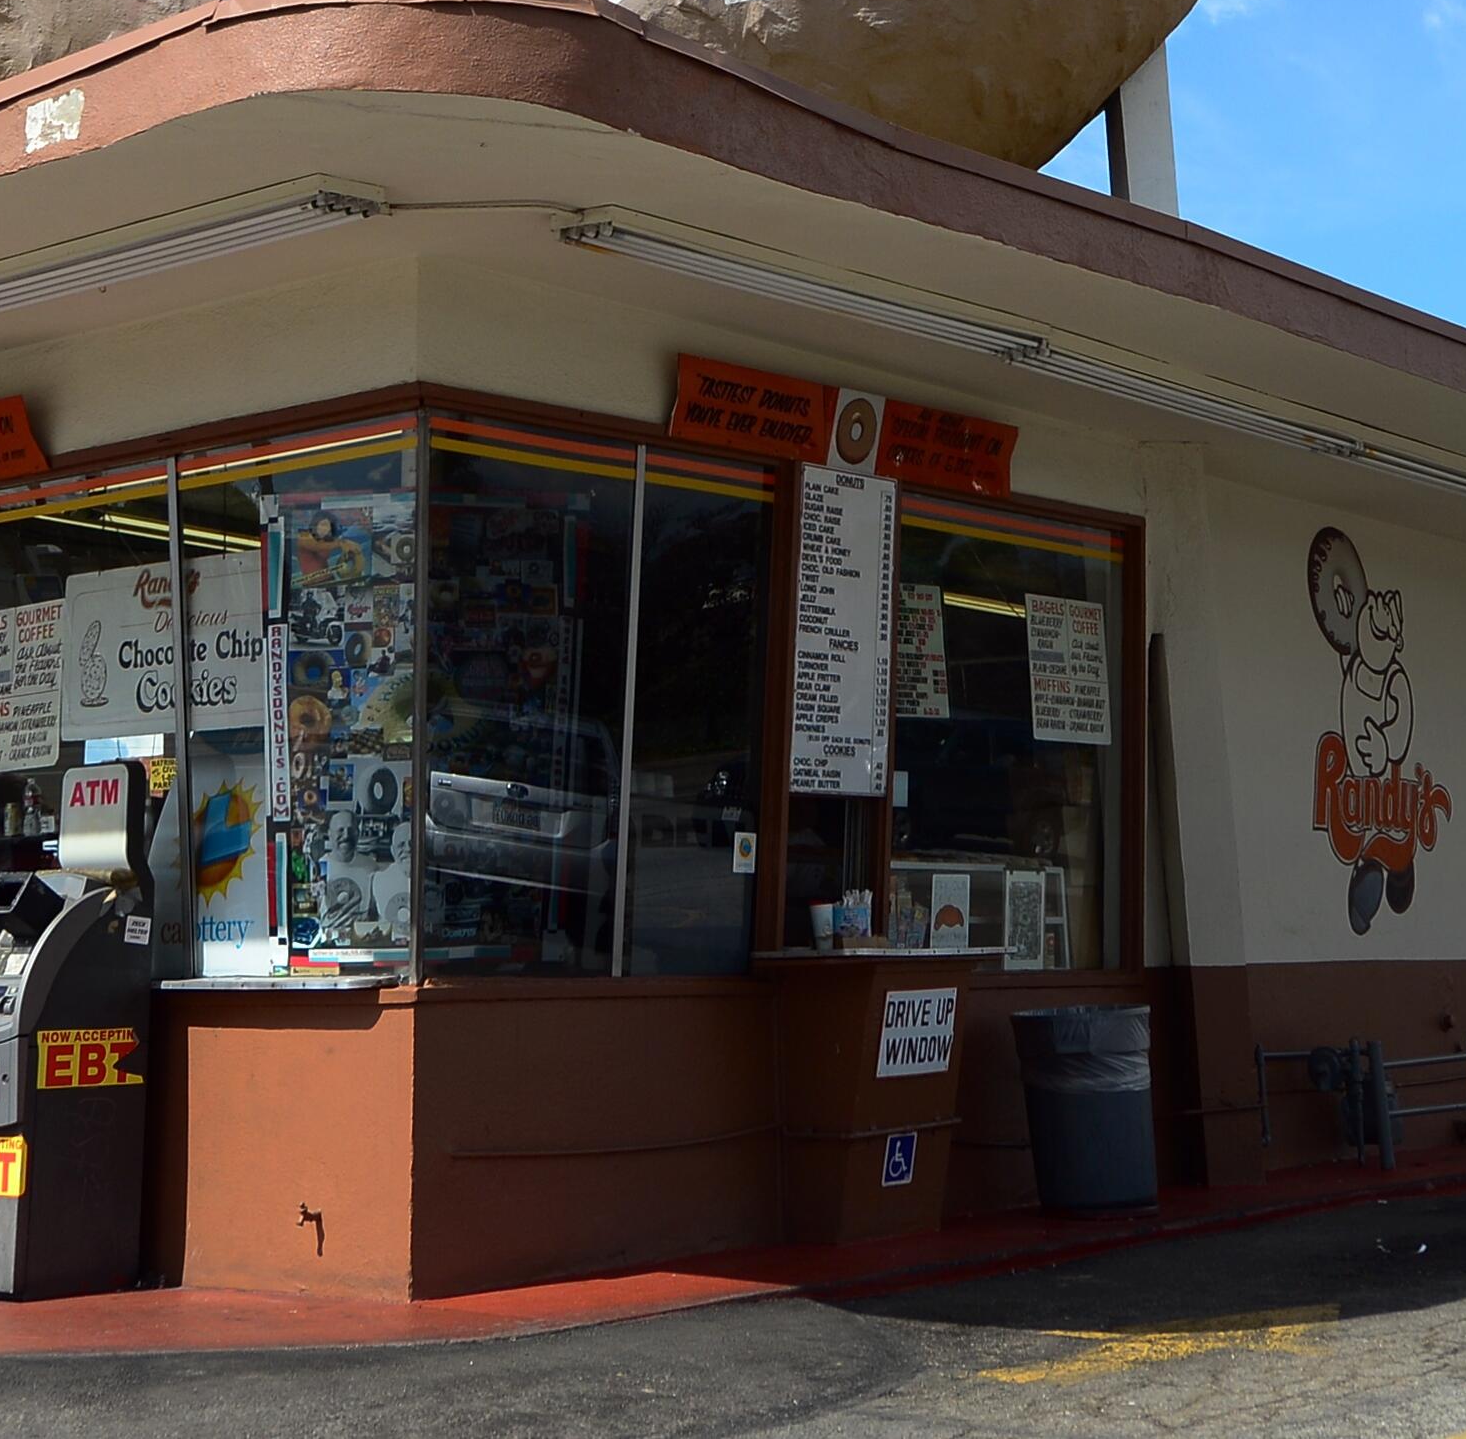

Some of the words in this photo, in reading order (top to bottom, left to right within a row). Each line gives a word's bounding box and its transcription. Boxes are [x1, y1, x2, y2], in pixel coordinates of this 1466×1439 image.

[758, 388, 811, 417] DONUTS
[0, 415, 14, 436] ON
[725, 410, 757, 434] EVER
[836, 474, 865, 489] DONUTS
[133, 568, 201, 609] Ran's
[16, 604, 62, 627] GOURMET
[1031, 599, 1064, 617] BAGELS
[1068, 604, 1102, 622] GOURMET
[154, 610, 229, 633] Decious
[1072, 619, 1100, 636] COFFEE
[18, 623, 54, 643] COFFEE
[118, 638, 207, 669] Chocote
[215, 630, 263, 661] Chip
[828, 638, 859, 651] FANCIES
[1033, 677, 1070, 694] MUFFINS
[12, 701, 52, 717] PINEAPPLE
[823, 744, 856, 757] COOKIES
[69, 778, 119, 807] ATM
[1312, 731, 1452, 865] Randy's
[885, 999, 932, 1028] DRIVE
[935, 997, 954, 1025] UP
[41, 1032, 72, 1043] NOW
[74, 1029, 134, 1042] ACCEPTIN
[884, 1034, 953, 1065] WINDOW
